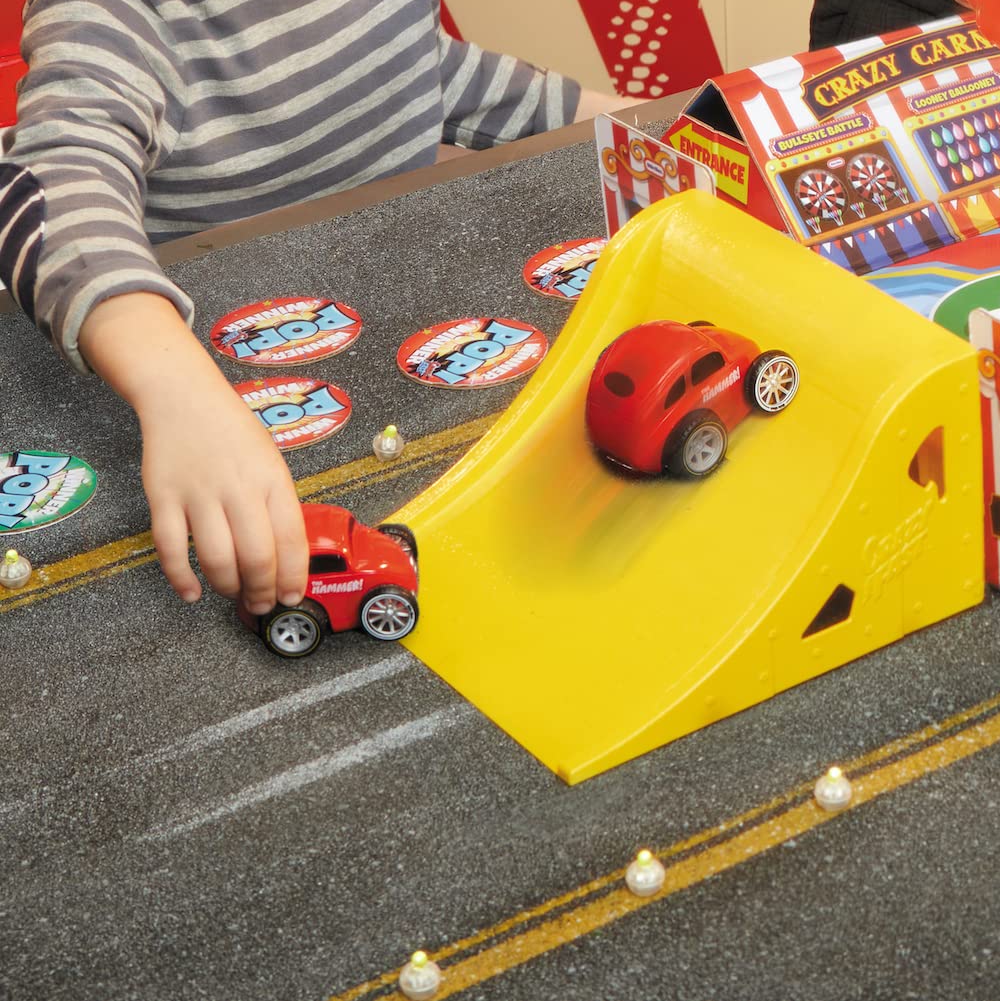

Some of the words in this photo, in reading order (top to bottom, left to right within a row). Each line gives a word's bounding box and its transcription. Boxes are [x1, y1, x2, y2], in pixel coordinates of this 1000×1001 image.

[813, 53, 901, 108] CRAZY
[914, 93, 948, 108] LOONEY
[949, 76, 996, 99] BALLOONEY
[777, 129, 827, 151] BULLSEYE
[828, 117, 864, 135] BATTLE
[680, 134, 745, 185] ENTRANCE
[221, 301, 311, 333] WINNER
[231, 302, 357, 359] POP!
[433, 320, 535, 386] POP!
[311, 579, 364, 594] HAMMER!
